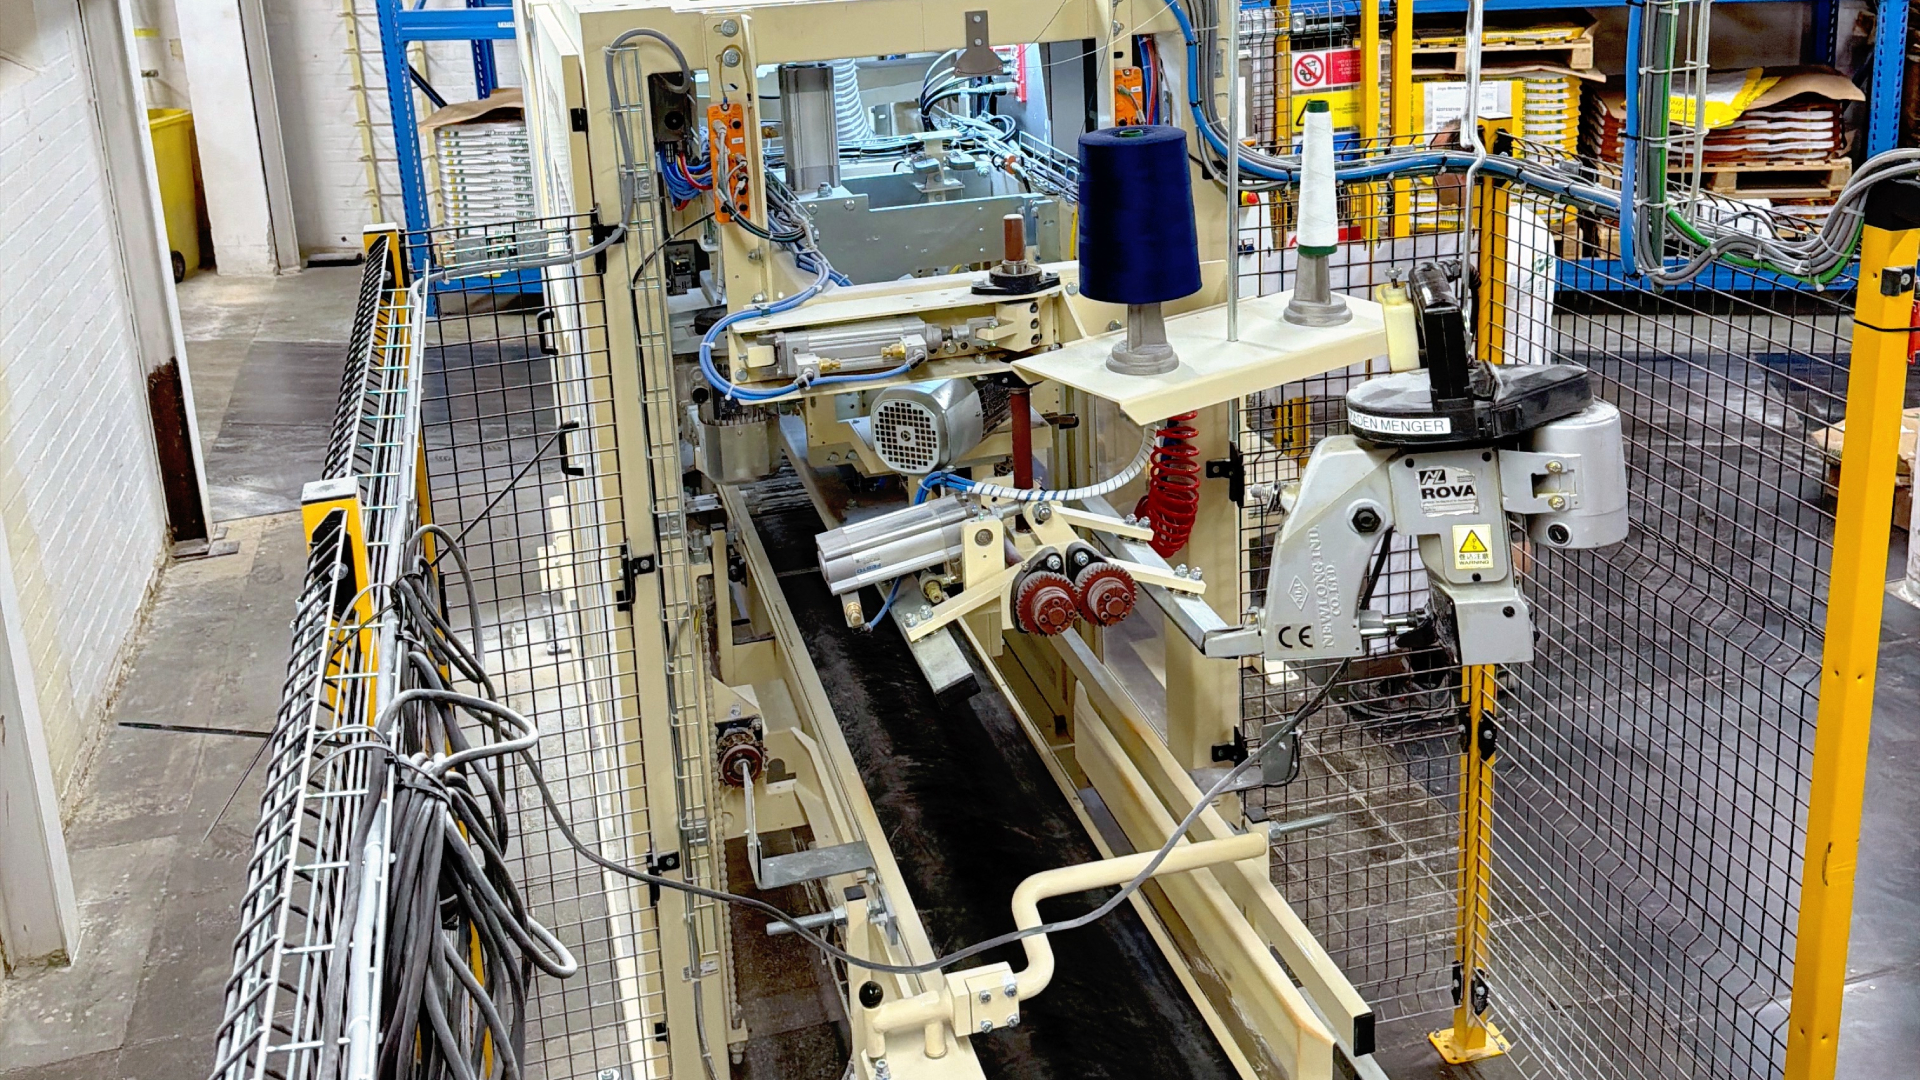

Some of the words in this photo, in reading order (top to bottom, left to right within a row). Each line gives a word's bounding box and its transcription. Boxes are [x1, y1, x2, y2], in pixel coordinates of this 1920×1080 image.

[1380, 419, 1445, 432] MENGER
[1421, 485, 1476, 499] ROVA
[1312, 561, 1335, 649] NEWLONG
[1278, 625, 1314, 649] CE
